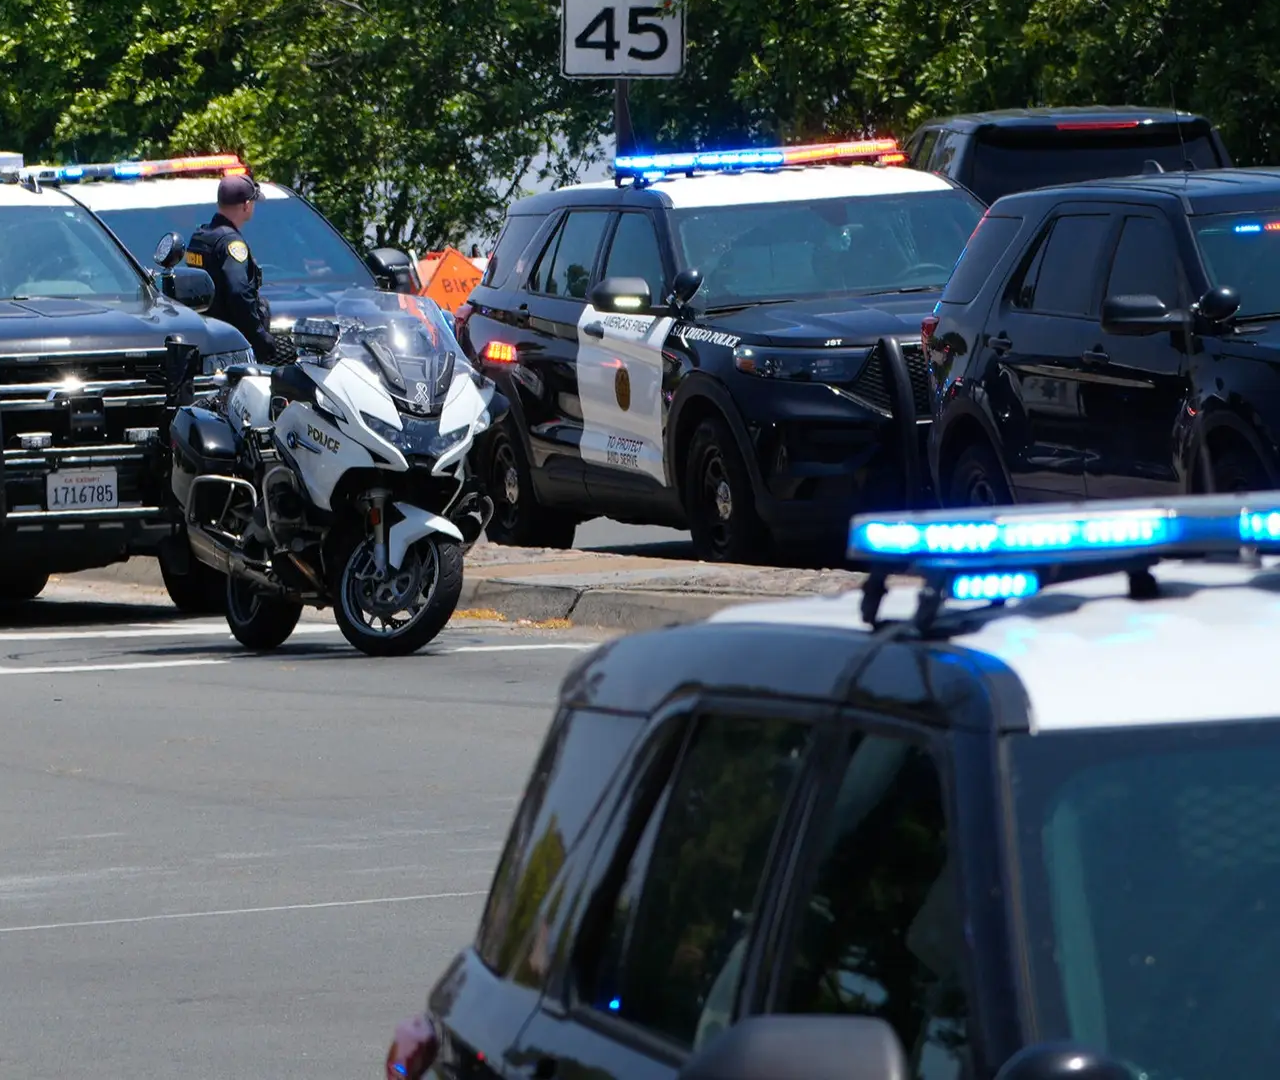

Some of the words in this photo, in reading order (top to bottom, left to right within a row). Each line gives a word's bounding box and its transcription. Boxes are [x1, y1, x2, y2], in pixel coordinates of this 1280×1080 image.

[574, 6, 669, 62] 45
[670, 324, 689, 337] SAN
[687, 325, 713, 343] DIEGO
[711, 329, 741, 348] POLICE
[306, 423, 341, 455] POLICE
[607, 435, 617, 449] TO
[615, 437, 644, 453] PROTECT
[52, 484, 113, 506] 1716785
